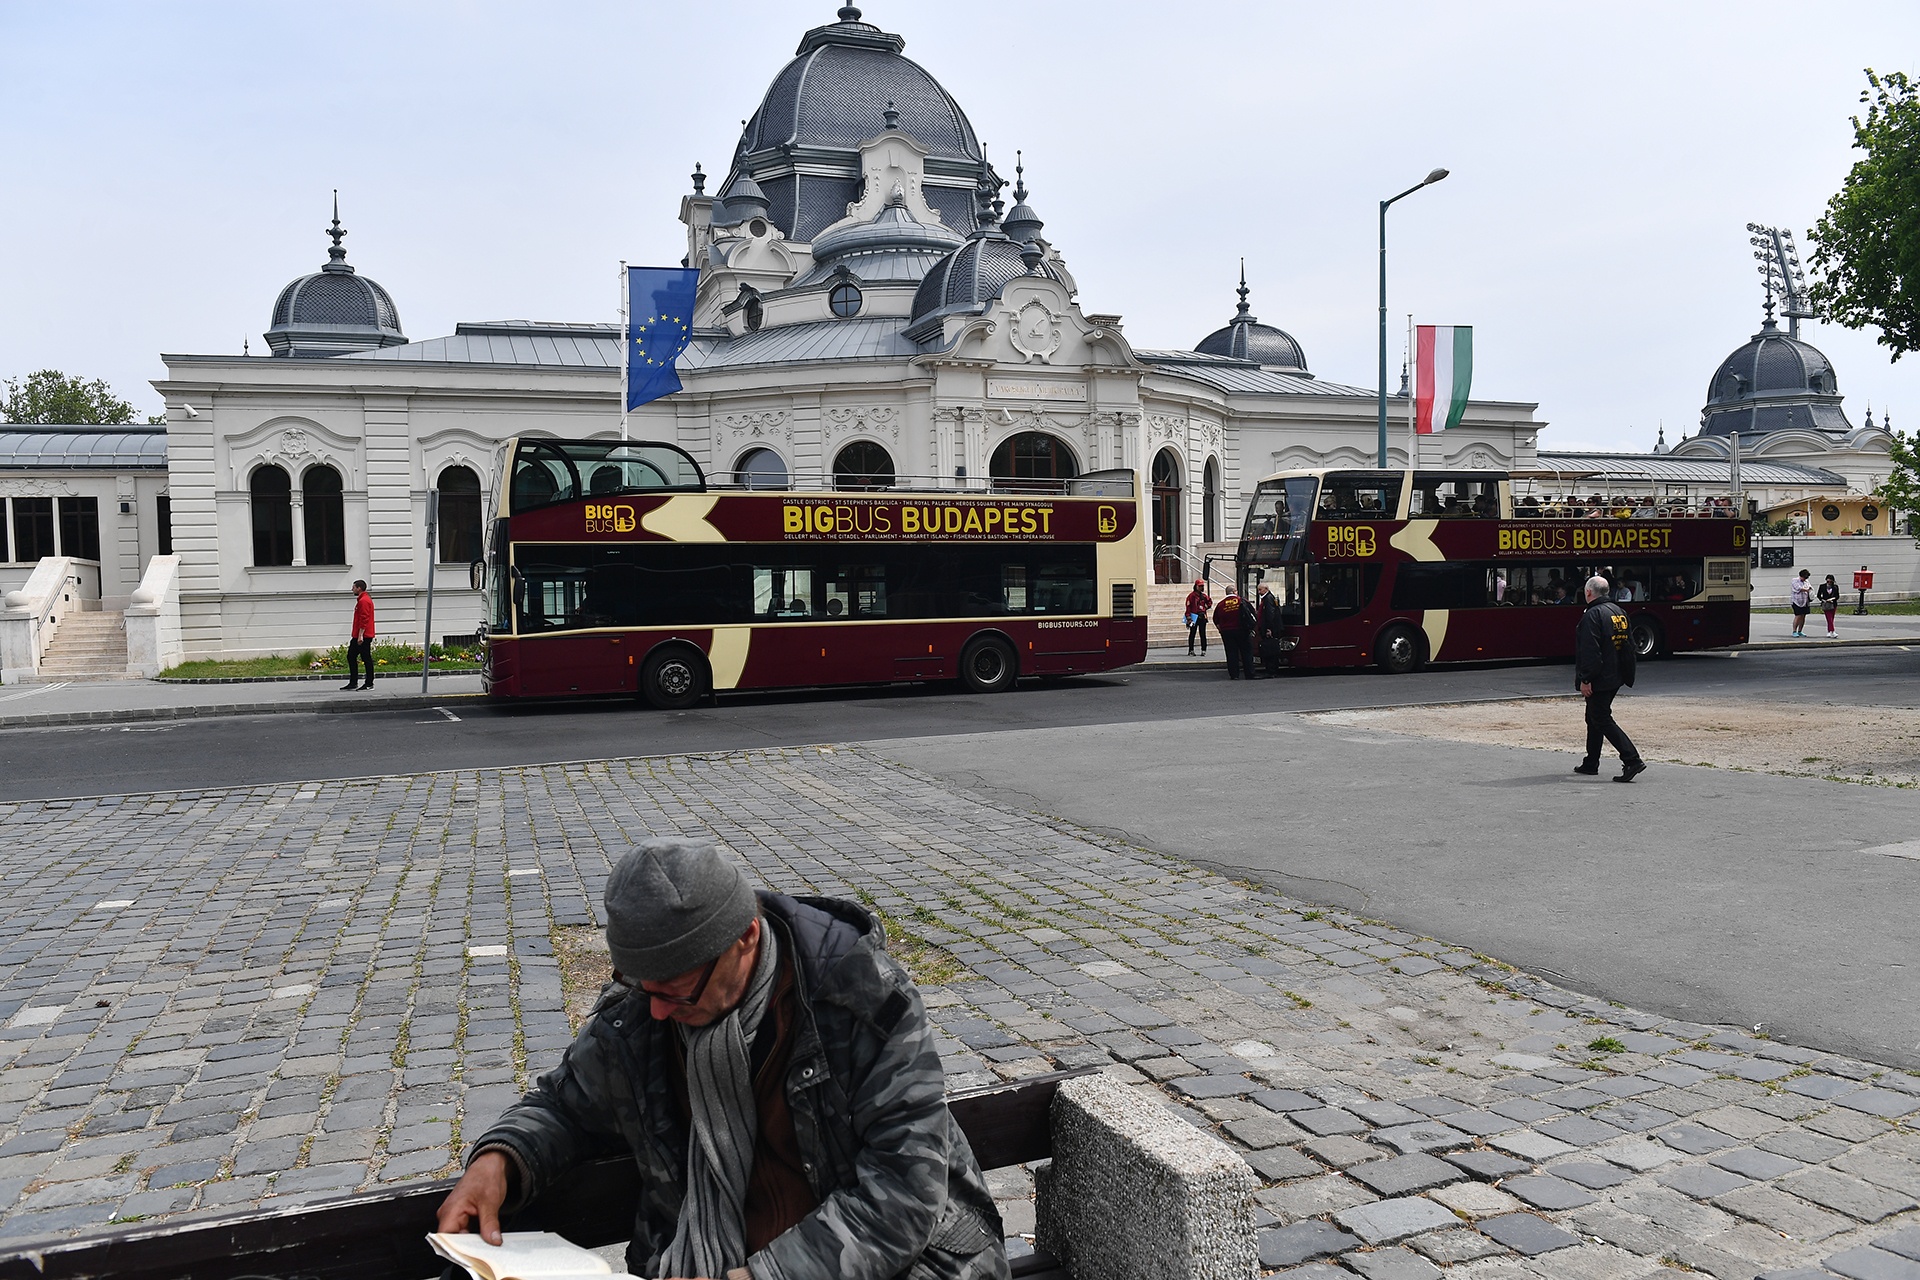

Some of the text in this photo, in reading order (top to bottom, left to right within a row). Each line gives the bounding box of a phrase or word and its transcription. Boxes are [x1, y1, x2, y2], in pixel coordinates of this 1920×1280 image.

[585, 505, 613, 519] BIG
[784, 506, 1054, 533] BIGBUS BUDAPEST
[586, 520, 614, 532] BUS
[1328, 526, 1354, 542] BIG
[1499, 529, 1672, 549] BIGBUS BUDAPEST
[1328, 543, 1355, 557] BUS
